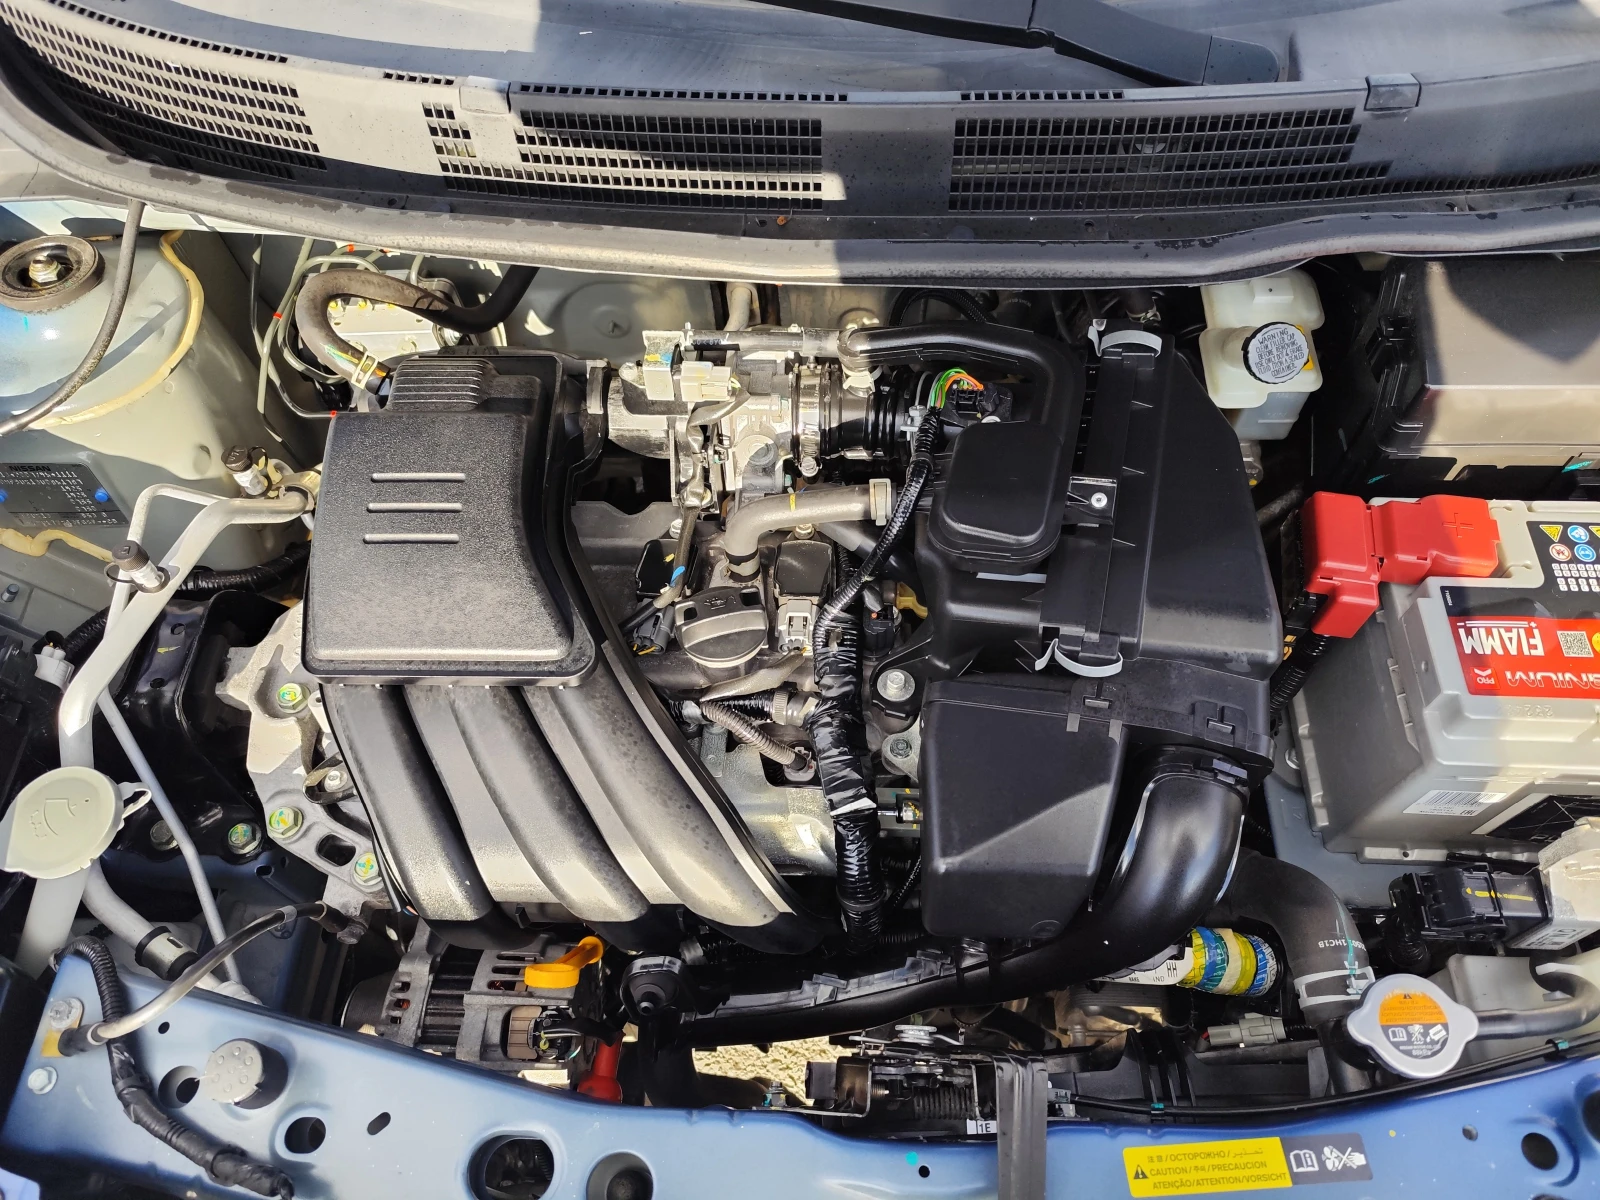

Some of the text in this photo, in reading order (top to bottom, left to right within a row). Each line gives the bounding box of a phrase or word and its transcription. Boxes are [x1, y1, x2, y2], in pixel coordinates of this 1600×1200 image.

[1258, 328, 1288, 345] WARNING
[1458, 628, 1544, 656] FIAMM
[1476, 677, 1495, 685] PRO
[1318, 939, 1348, 949] 1HC1B
[979, 1123, 991, 1132] 1E
[1150, 1166, 1188, 1176] CAUTION
